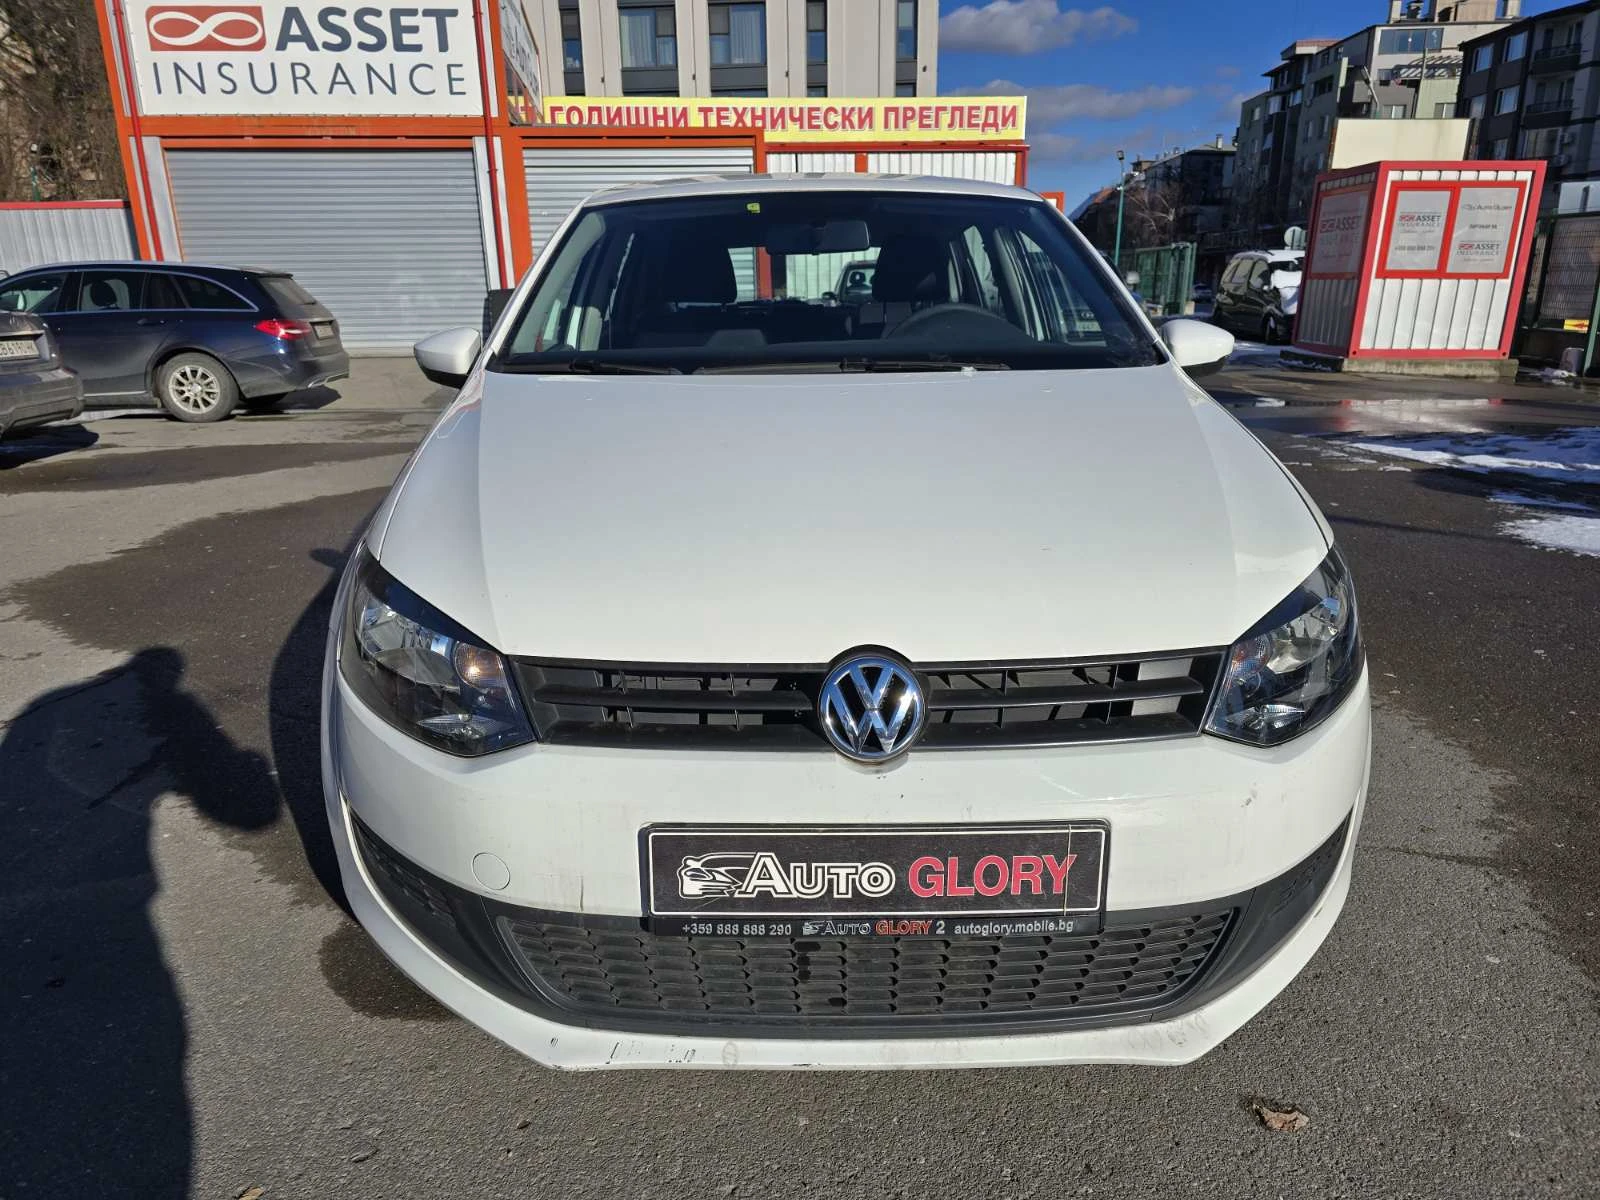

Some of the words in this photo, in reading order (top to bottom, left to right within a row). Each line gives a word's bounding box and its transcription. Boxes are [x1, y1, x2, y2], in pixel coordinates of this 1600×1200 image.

[275, 6, 459, 53] ASSET
[152, 61, 467, 96] INSURANCE
[549, 105, 688, 128] ГОДИШНИ
[697, 105, 874, 130] ТЕХНИЧЕСКИ
[883, 104, 1017, 132] ПРЕГЛЕДИ
[1415, 214, 1442, 222] ASSET
[907, 854, 1078, 898] GLORY
[682, 923, 713, 935] +359
[716, 923, 739, 935] 888
[743, 923, 766, 935] 888
[769, 923, 792, 936] 290
[875, 920, 933, 935] GLORY
[936, 920, 945, 935] 2
[954, 919, 1074, 936] autoglory.mobile.bg
